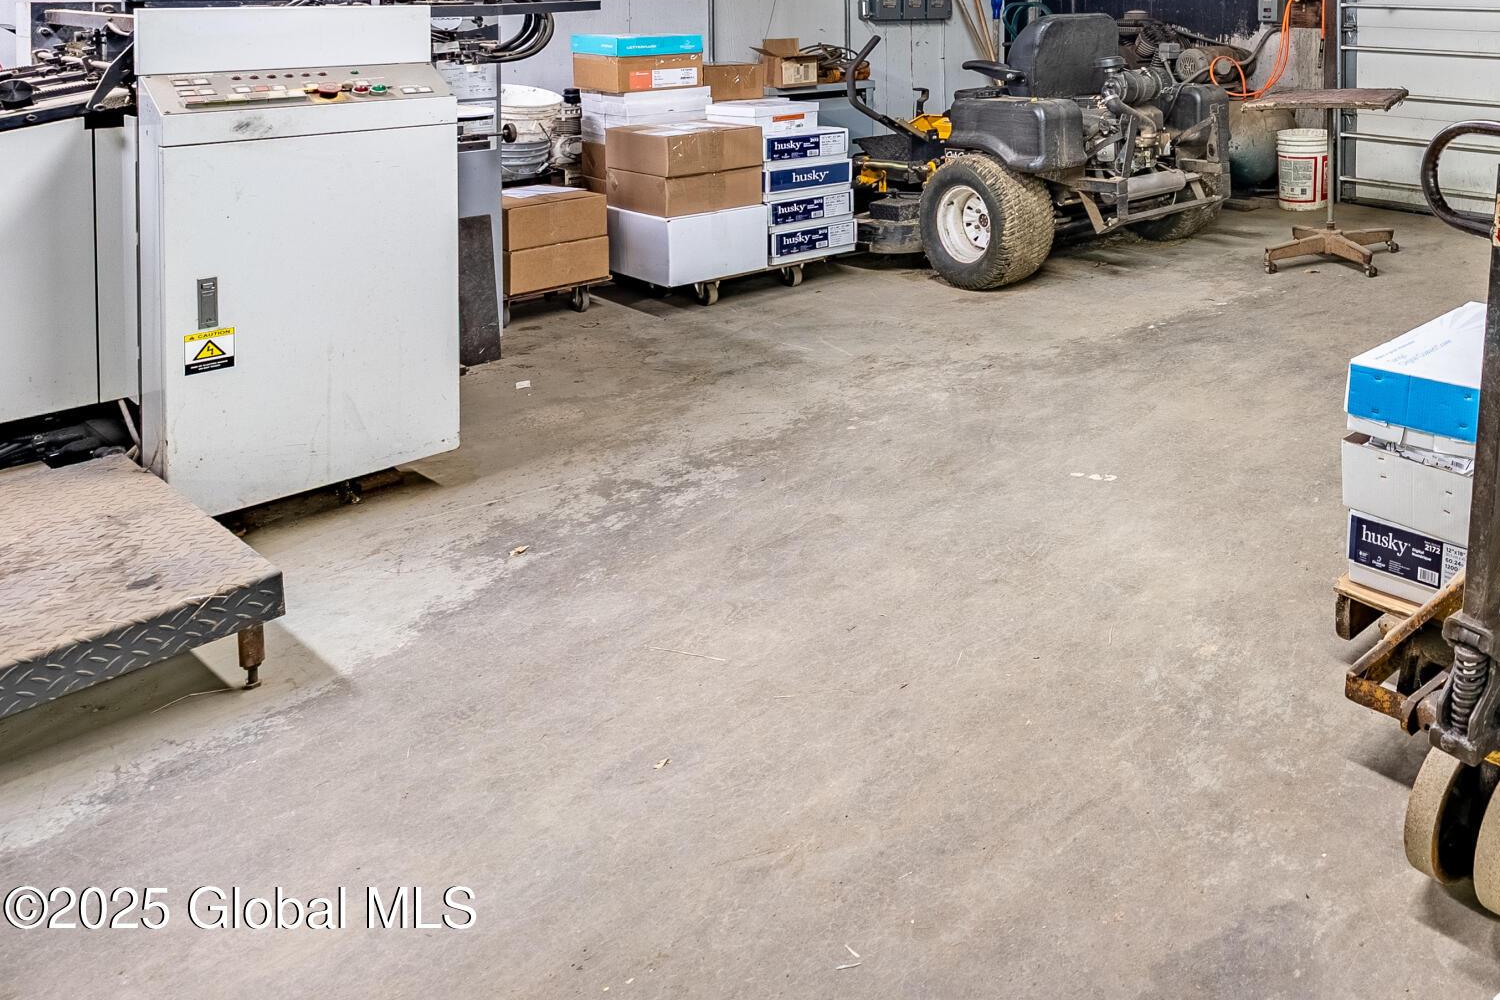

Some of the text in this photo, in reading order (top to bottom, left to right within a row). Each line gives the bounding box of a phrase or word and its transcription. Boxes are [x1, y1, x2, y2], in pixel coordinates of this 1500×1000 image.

[774, 140, 802, 150] husky
[792, 170, 828, 182] husky
[778, 204, 806, 214] husky
[783, 233, 810, 244] husky
[1362, 525, 1407, 556] husky
[1425, 544, 1441, 555] 2172
